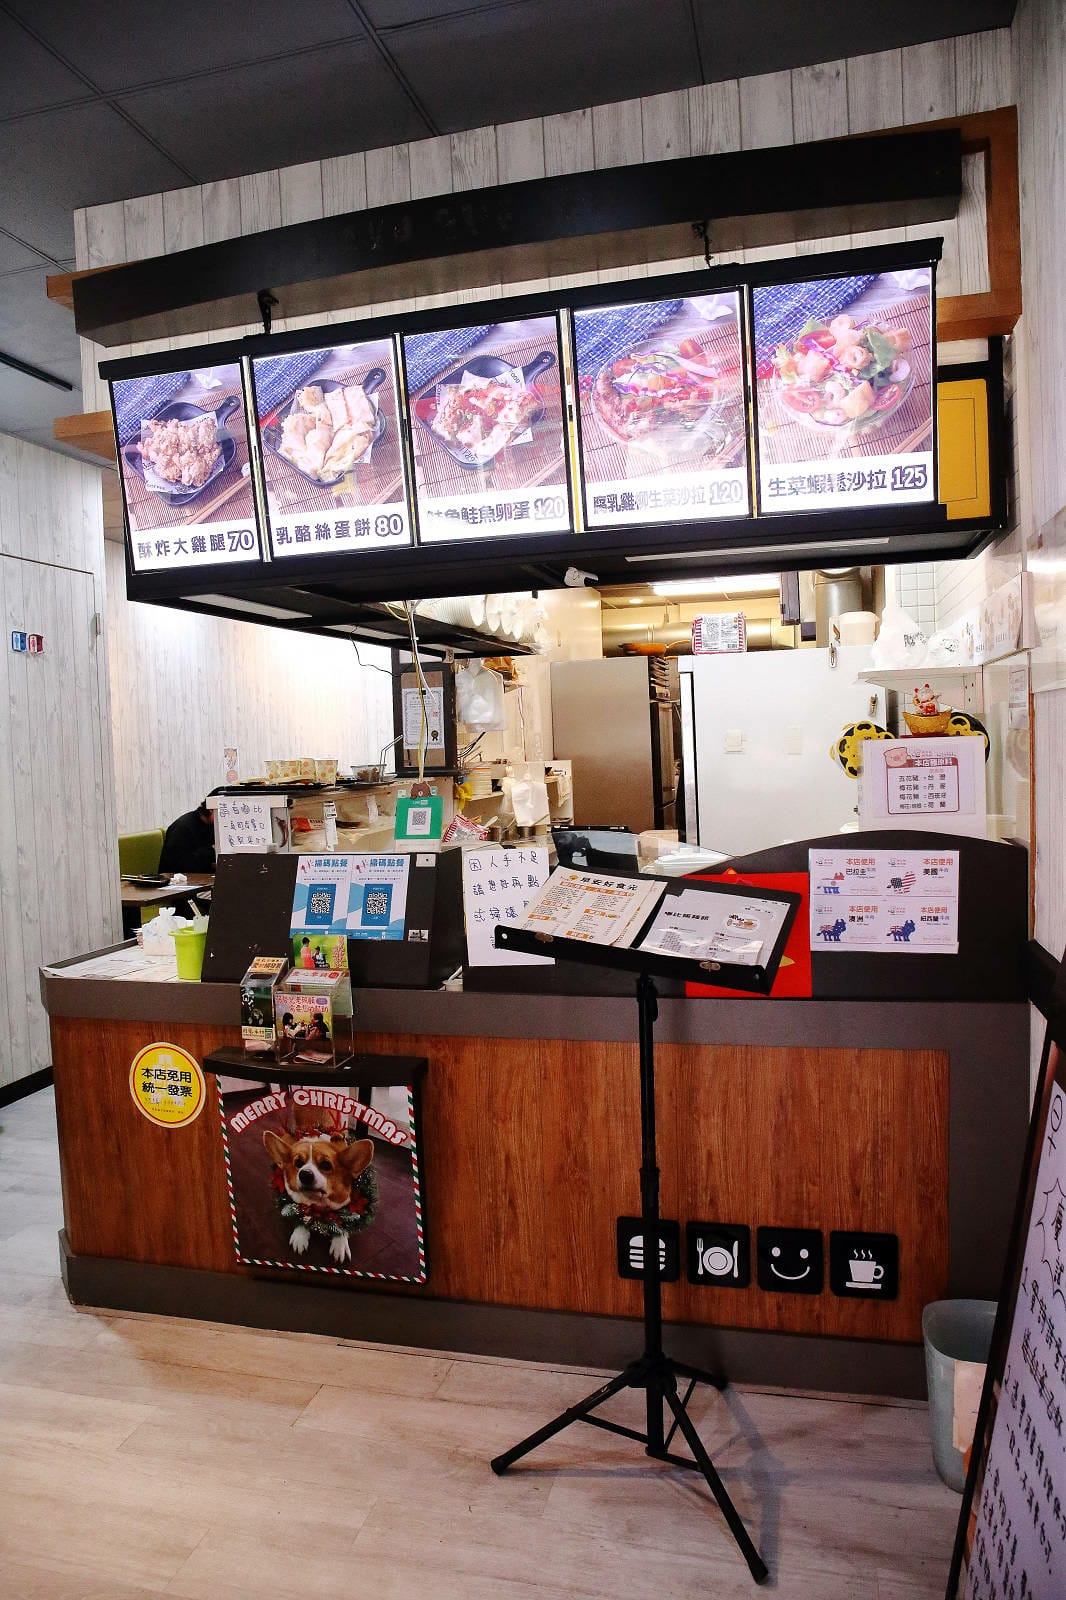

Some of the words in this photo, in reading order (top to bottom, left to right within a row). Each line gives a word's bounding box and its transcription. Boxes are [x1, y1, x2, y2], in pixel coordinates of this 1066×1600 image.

[891, 464, 928, 492] 125
[709, 480, 744, 506] 120
[533, 496, 566, 521] 120
[275, 518, 371, 545] 乳酪絲蛋餅
[375, 513, 404, 538] 80
[137, 534, 226, 559] 酥炸大雞腿
[227, 529, 254, 553] 70
[468, 850, 539, 872] 因人手不足
[846, 858, 876, 866] 本店使用
[922, 858, 954, 866] 本店使用
[923, 868, 938, 876] 美國
[848, 905, 879, 913] 本店使用
[141, 1067, 192, 1084] 本店免用
[142, 1081, 193, 1098] 統一發票
[230, 1091, 287, 1134] MERRY
[292, 1088, 407, 1145] CHRISTMAS
